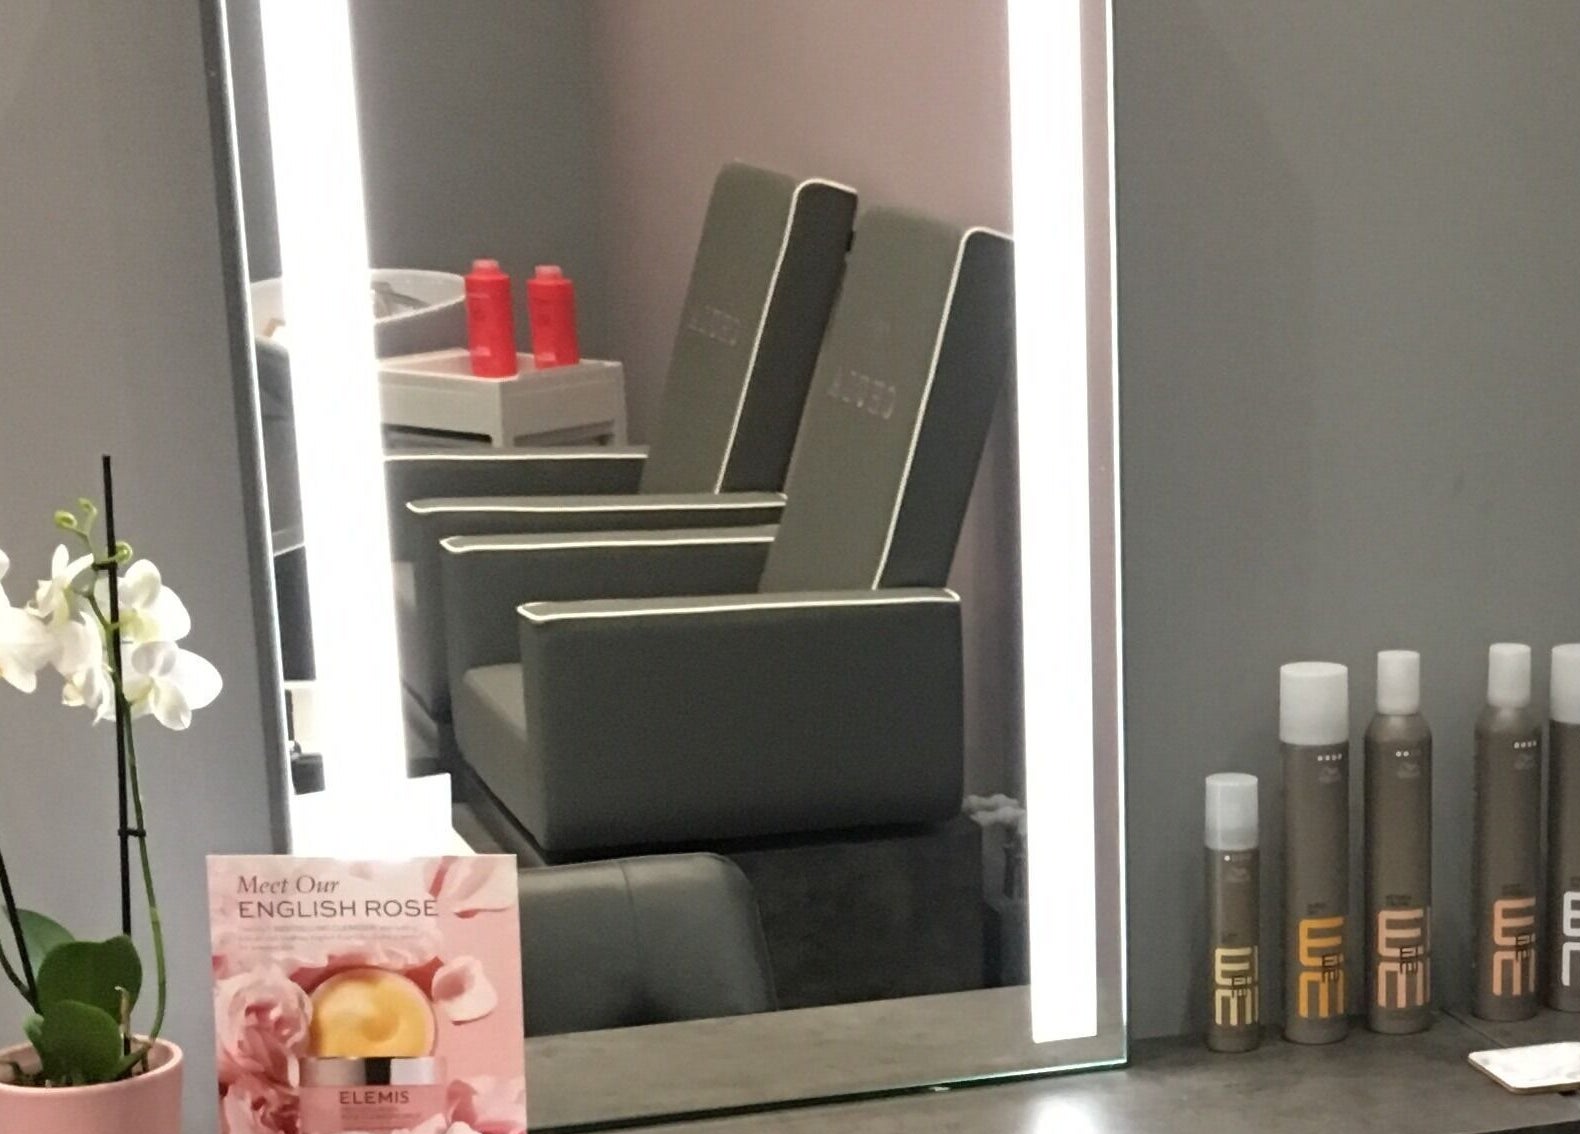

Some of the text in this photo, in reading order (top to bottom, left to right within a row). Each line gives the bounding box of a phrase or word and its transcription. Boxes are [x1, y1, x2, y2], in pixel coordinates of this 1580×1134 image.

[237, 875, 340, 895] Meet Our
[238, 900, 439, 918] ENGLISH ROSE
[339, 1091, 410, 1105] ELEMIS
